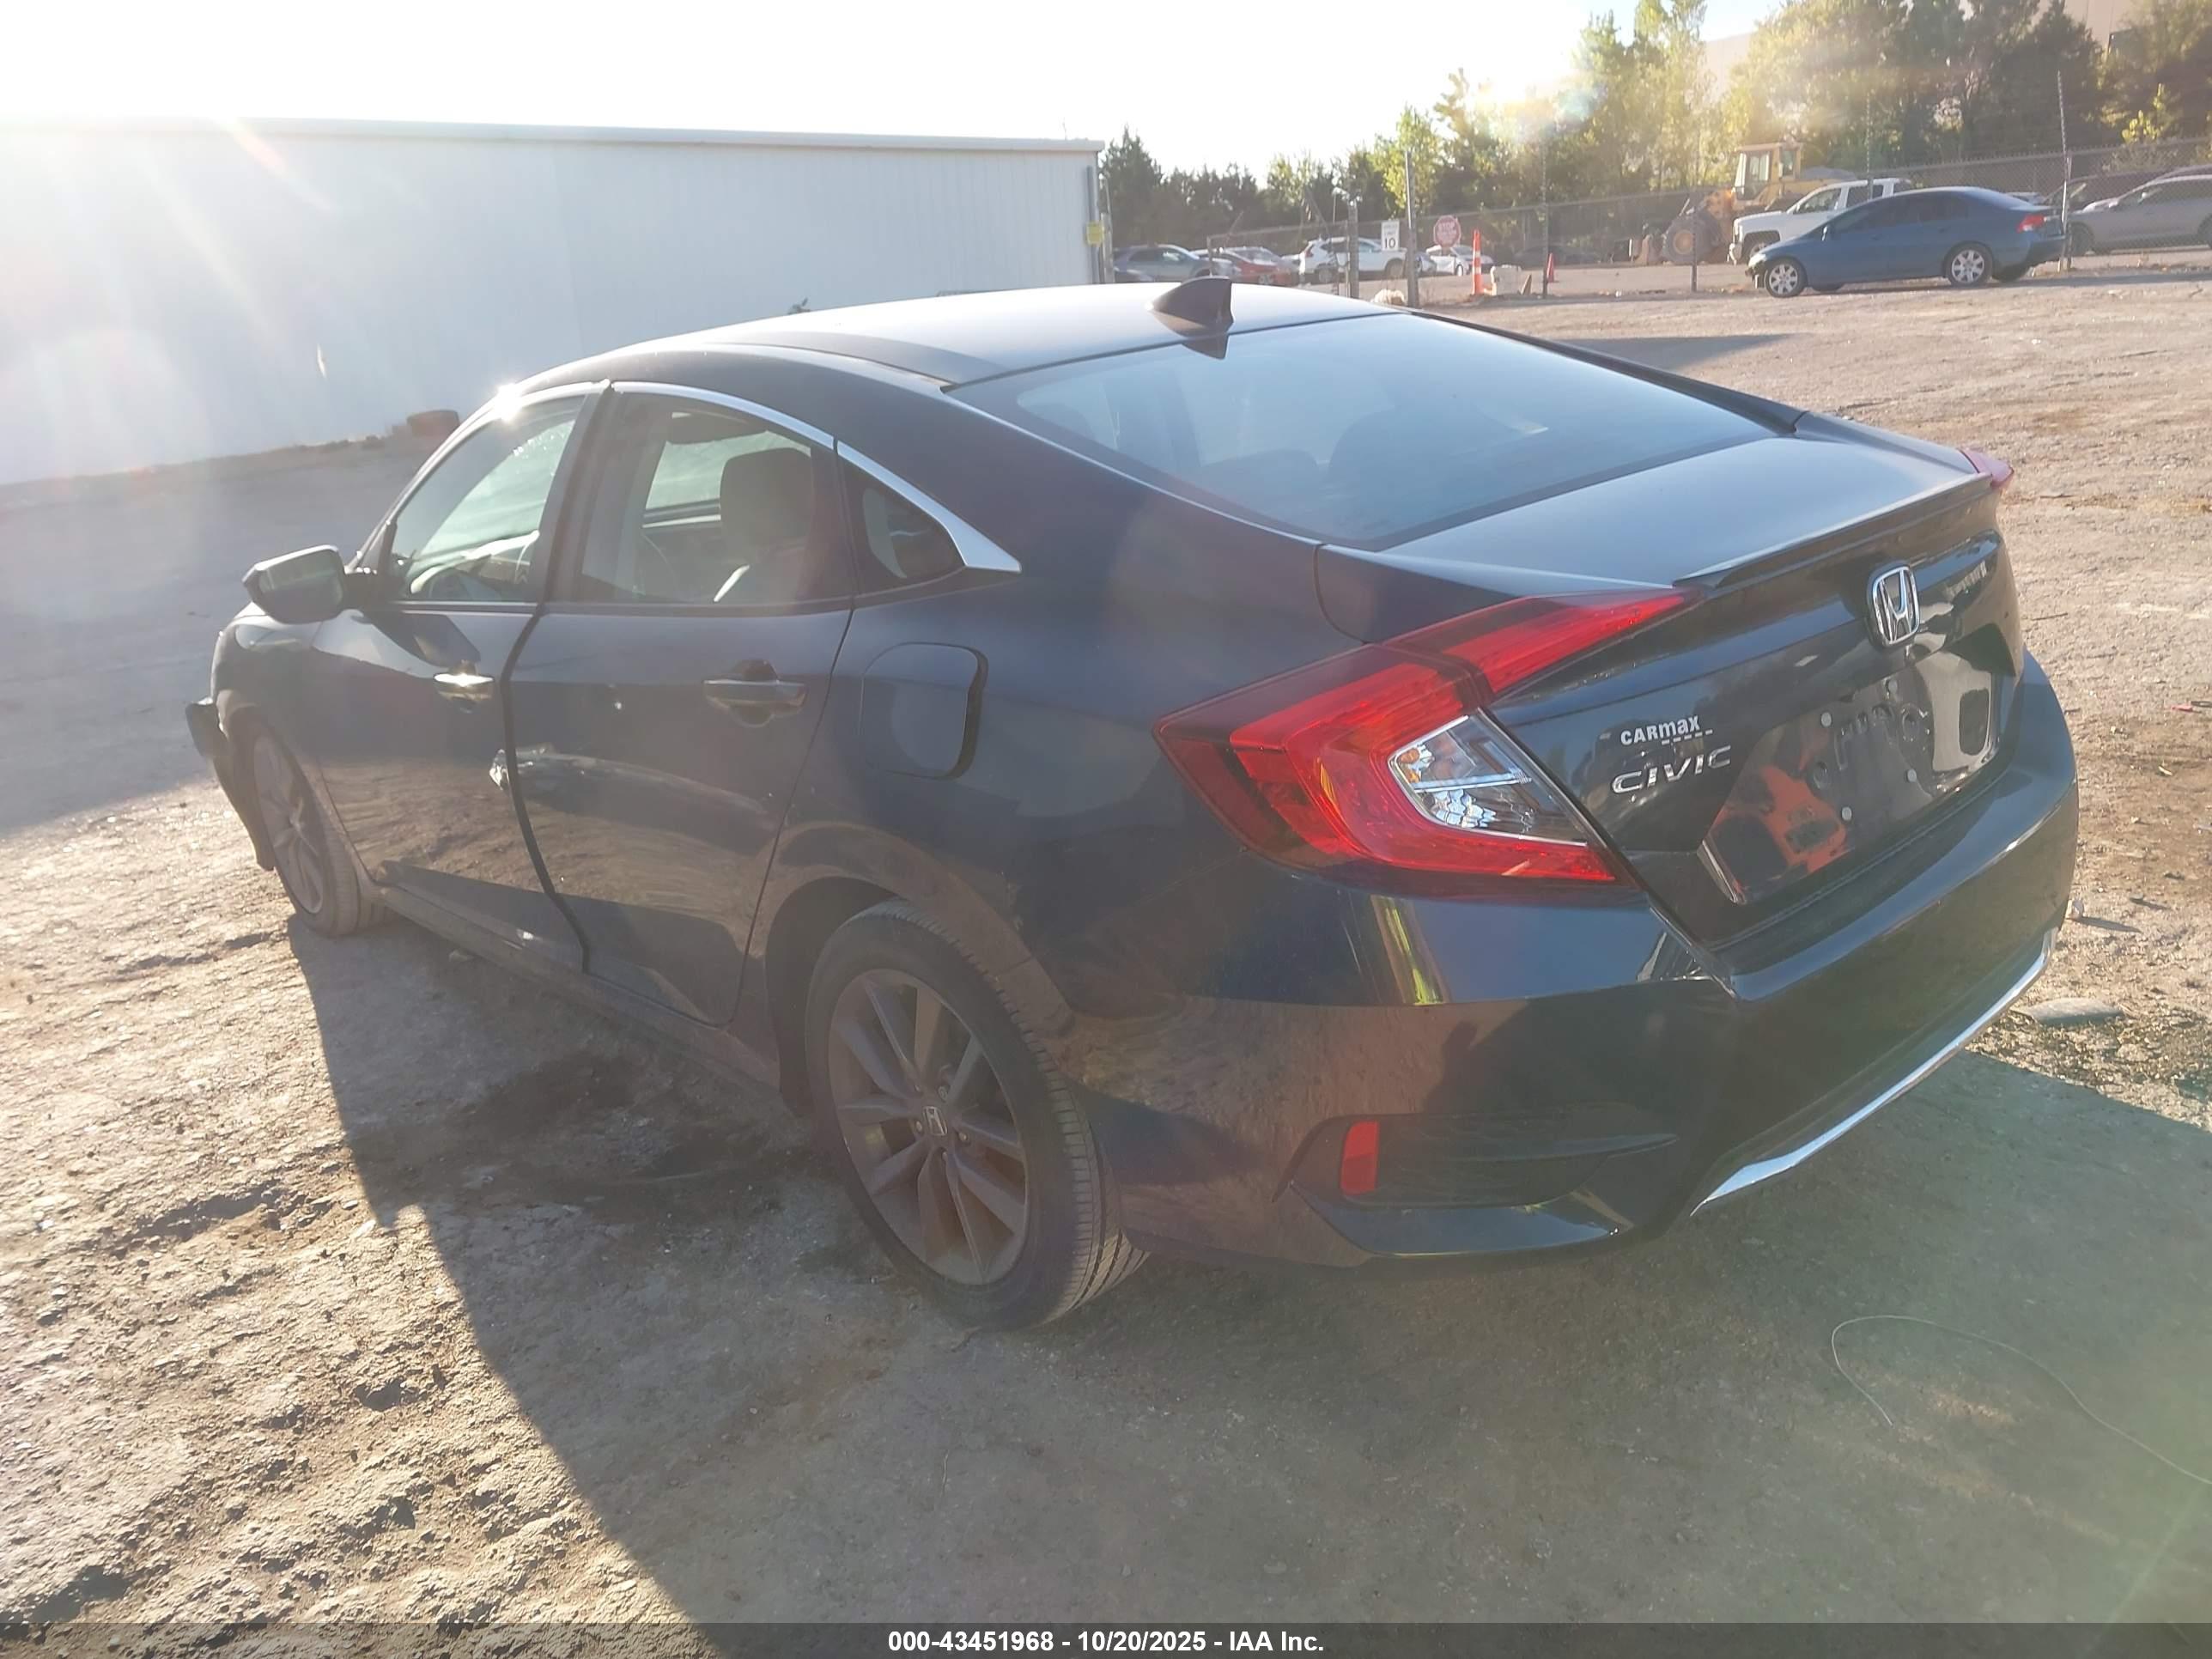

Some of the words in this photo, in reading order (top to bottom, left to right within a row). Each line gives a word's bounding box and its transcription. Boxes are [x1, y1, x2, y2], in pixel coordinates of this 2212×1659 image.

[1384, 237, 1396, 248] 10
[1620, 715, 1701, 745] CARmax
[1612, 744, 1731, 793] CIVIC
